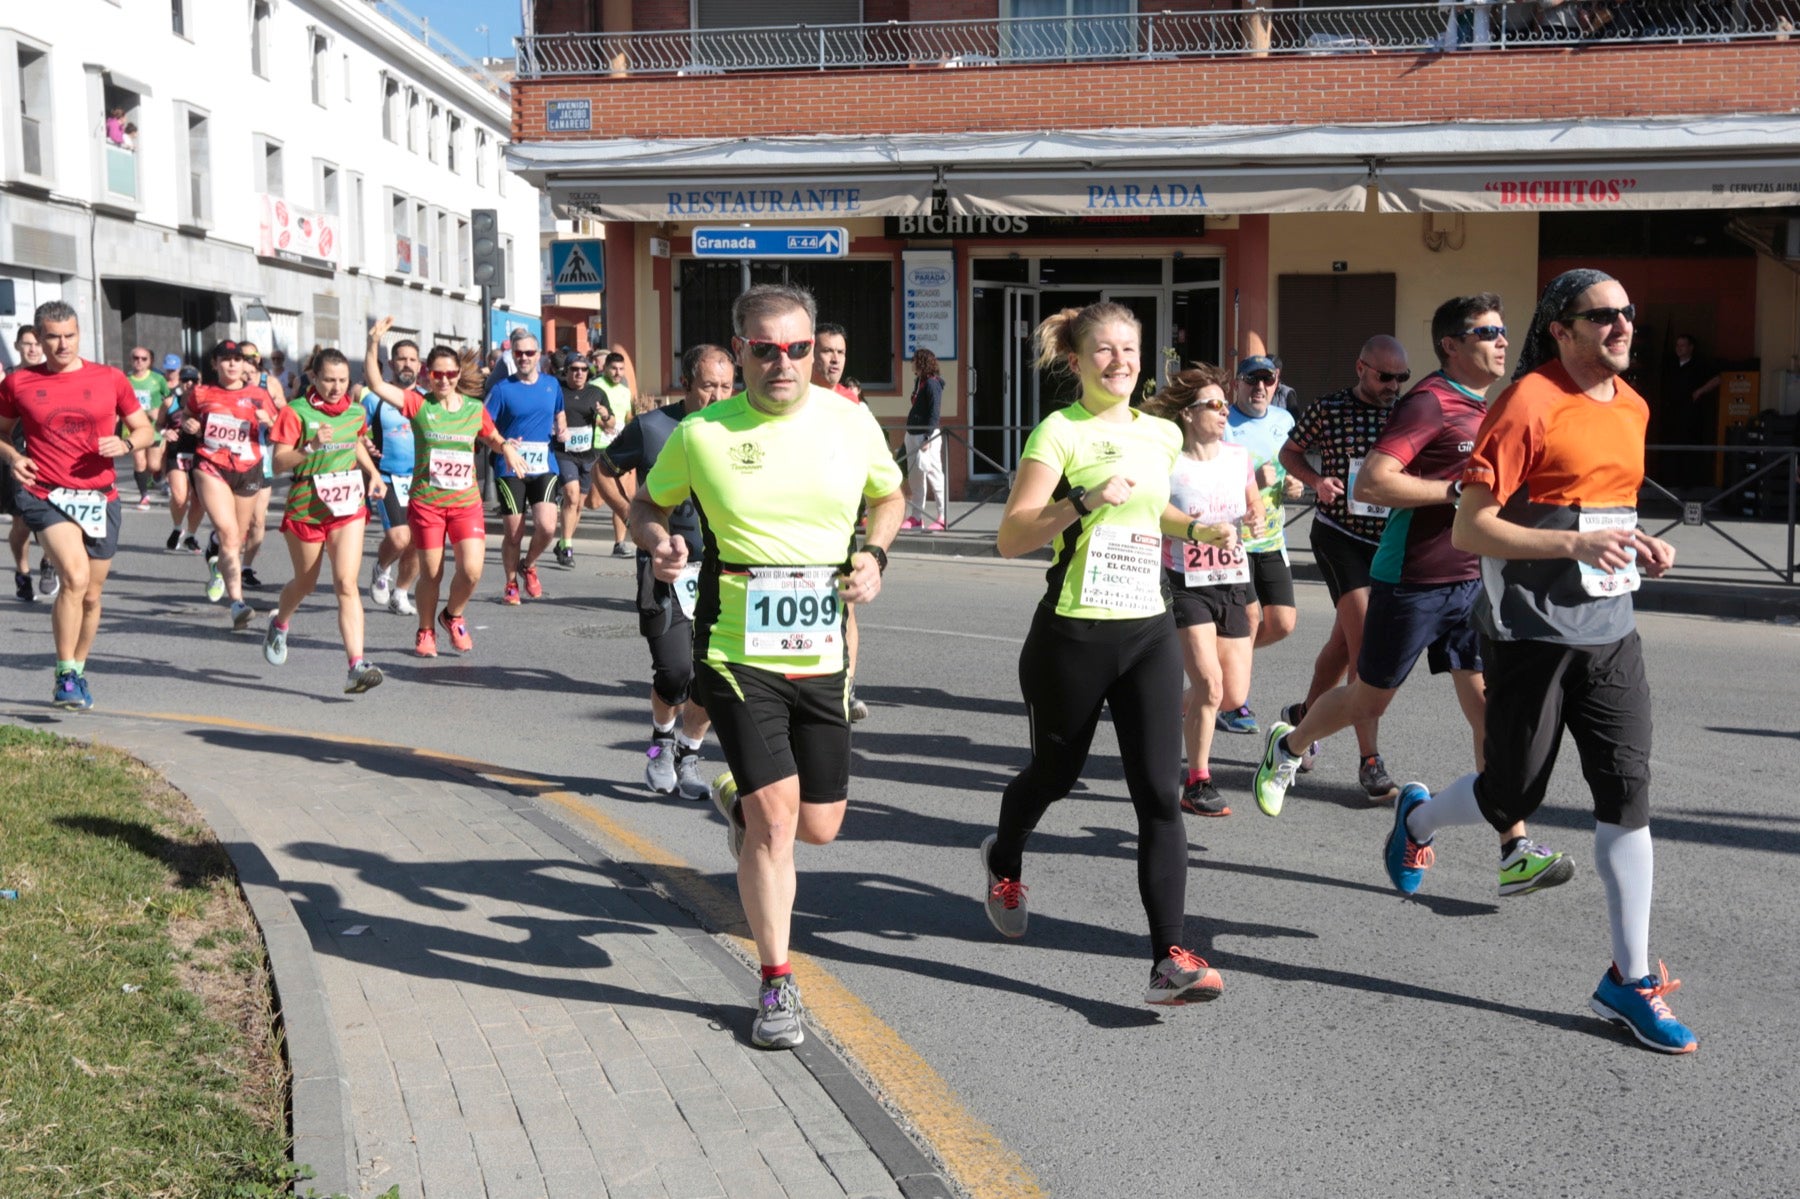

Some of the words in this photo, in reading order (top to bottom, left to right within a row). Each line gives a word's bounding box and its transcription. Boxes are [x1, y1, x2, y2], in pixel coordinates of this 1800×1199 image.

[557, 101, 589, 109] AVENIDA
[560, 109, 587, 119] JACOBO
[550, 119, 590, 129] CAMARERO
[1730, 183, 1774, 193] CERVEZAS
[667, 188, 861, 215] RESTAURANTE
[1087, 184, 1208, 208] PARADA
[899, 214, 1029, 234] BICHITOS
[697, 237, 756, 249] Granada
[789, 237, 817, 248] A-44
[570, 433, 589, 446] 896
[434, 461, 471, 478] 2227
[57, 503, 102, 522] 075
[1104, 552, 1136, 562] CORRO
[1120, 565, 1151, 574] CANCER
[754, 596, 837, 627] 1099
